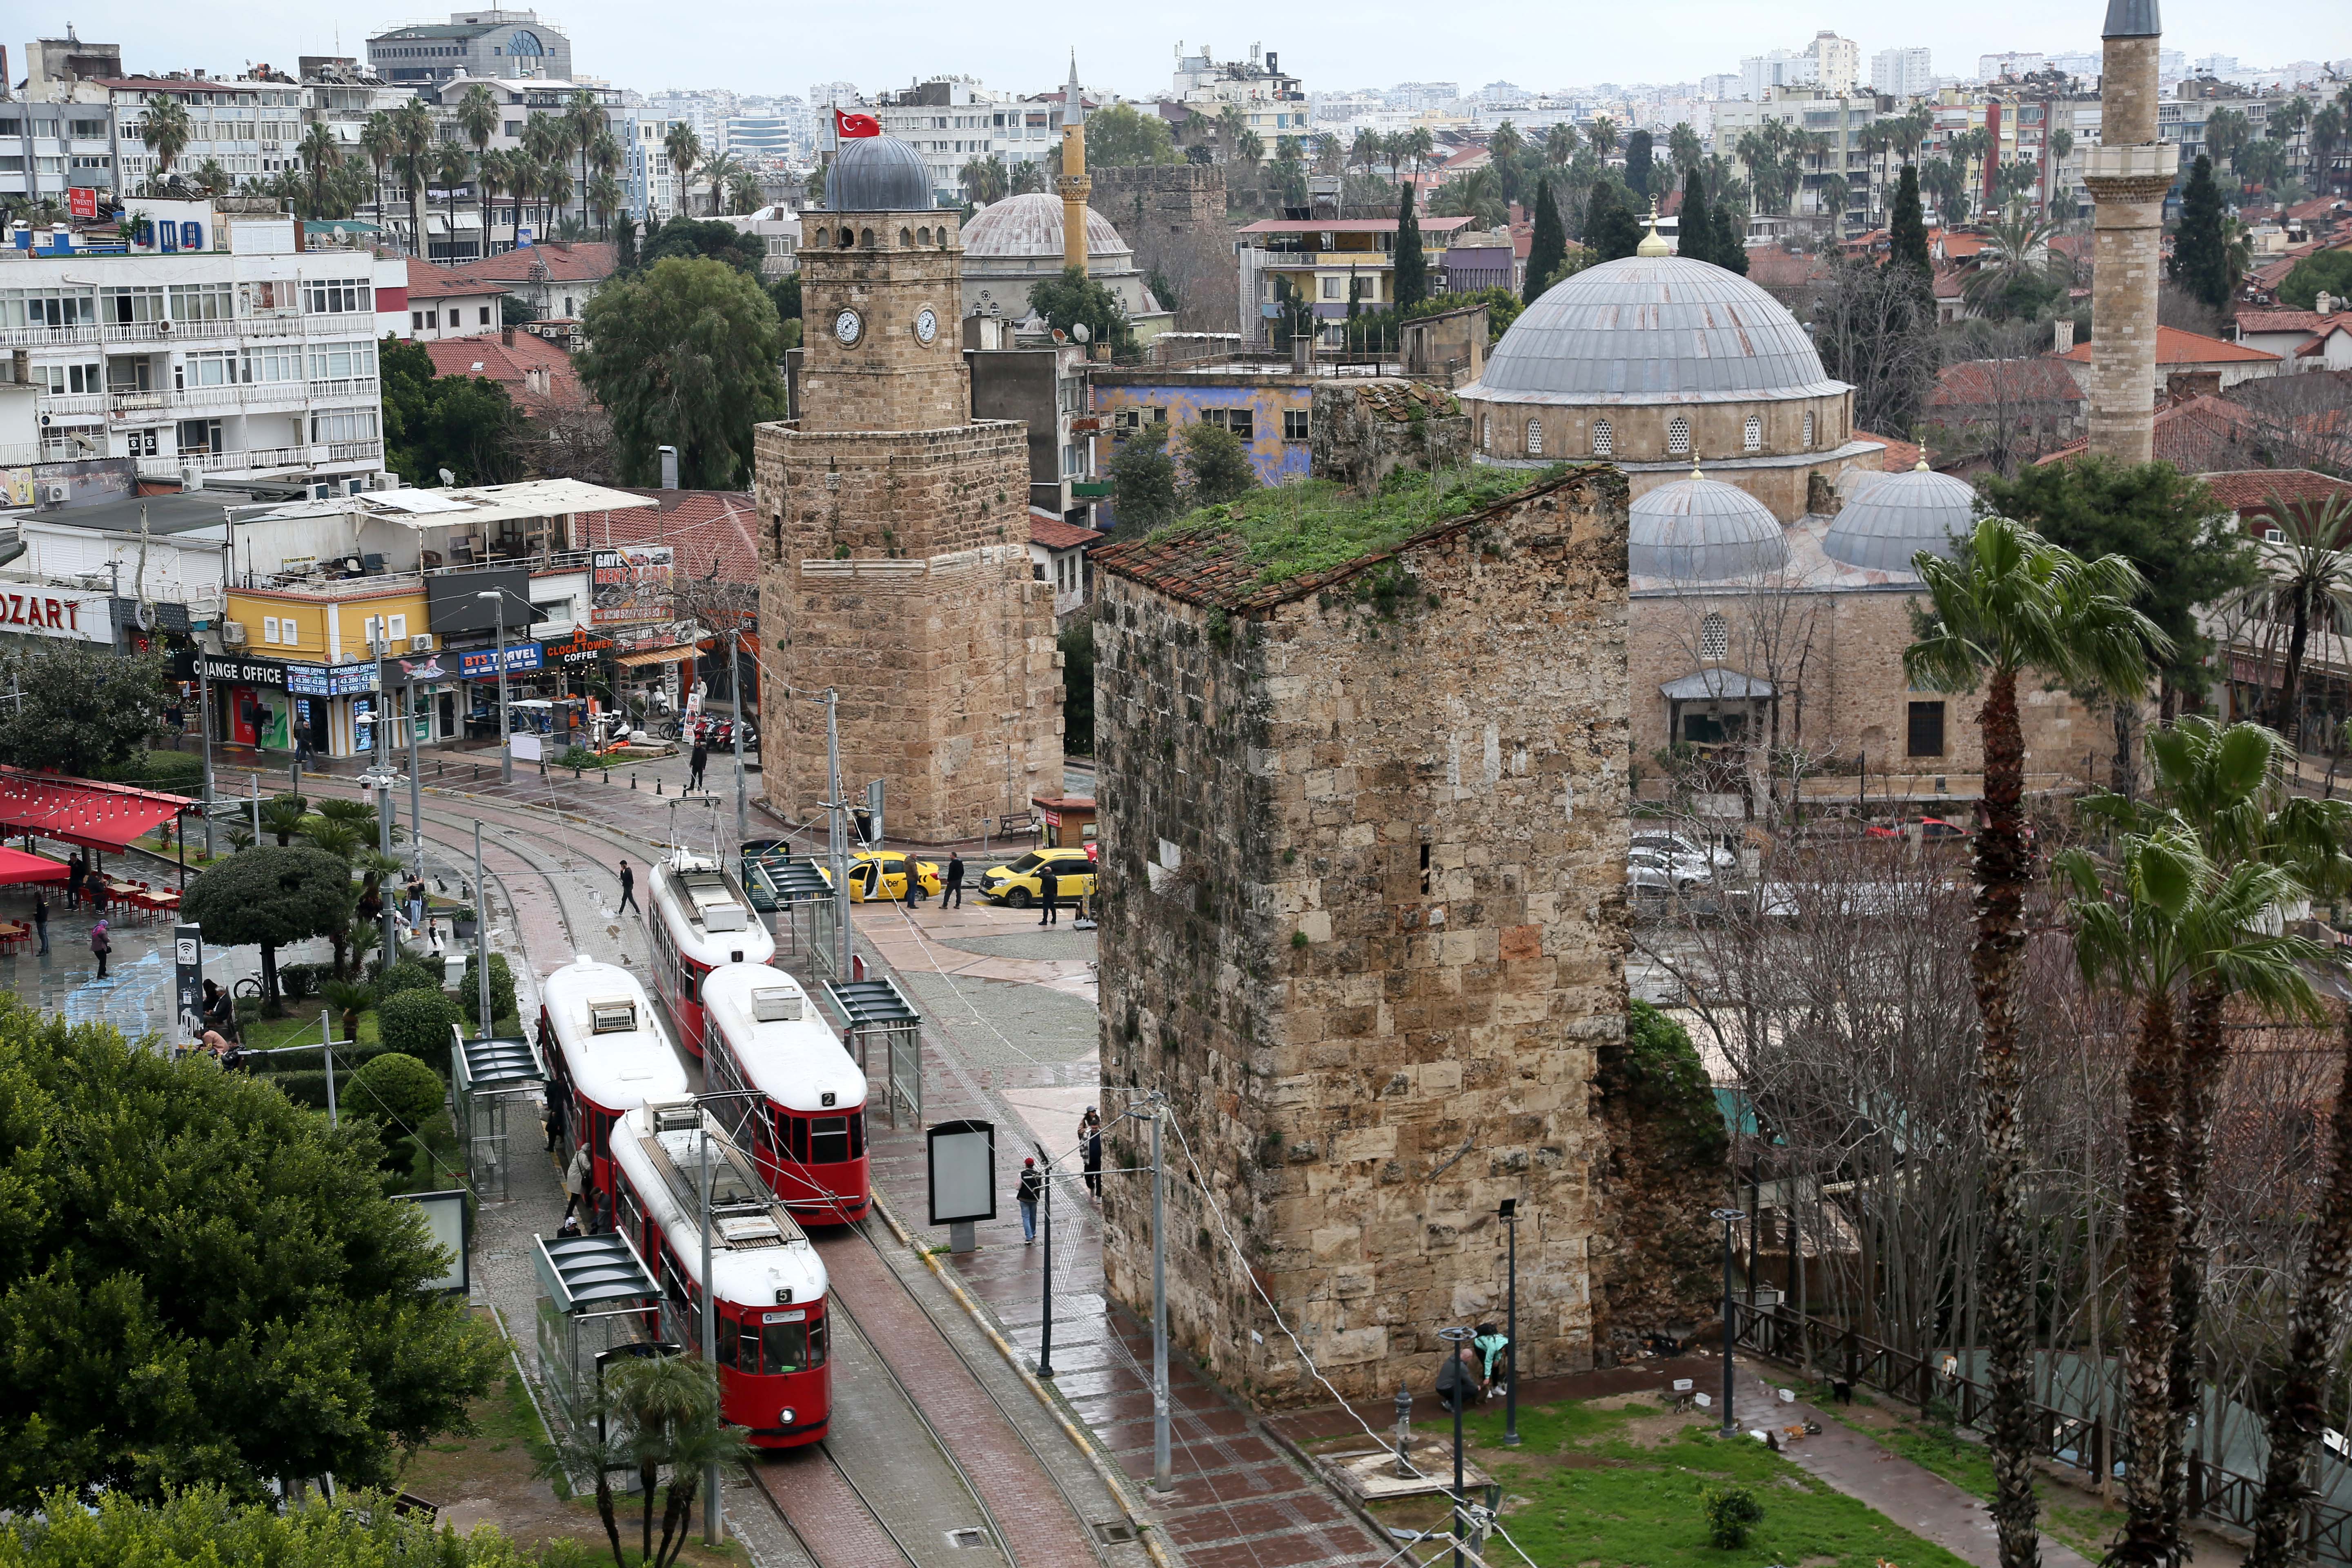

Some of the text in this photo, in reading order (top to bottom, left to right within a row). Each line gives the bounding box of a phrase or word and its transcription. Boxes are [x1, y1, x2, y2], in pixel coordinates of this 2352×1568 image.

[73, 198, 92, 206] TWENTY
[595, 553, 623, 568] GAYE
[595, 568, 629, 584] RENT
[636, 628, 653, 640] GAYE
[547, 639, 613, 657] CLOCK TOWER
[464, 654, 488, 667] BTS
[564, 650, 598, 662] COFFEE
[243, 666, 282, 684] OFFICE
[287, 665, 310, 673] EXCHANGE
[330, 665, 359, 675] EXCHANGE
[882, 879, 900, 888] Uber
[824, 1094, 832, 1105] 2
[779, 1290, 788, 1301] 5
